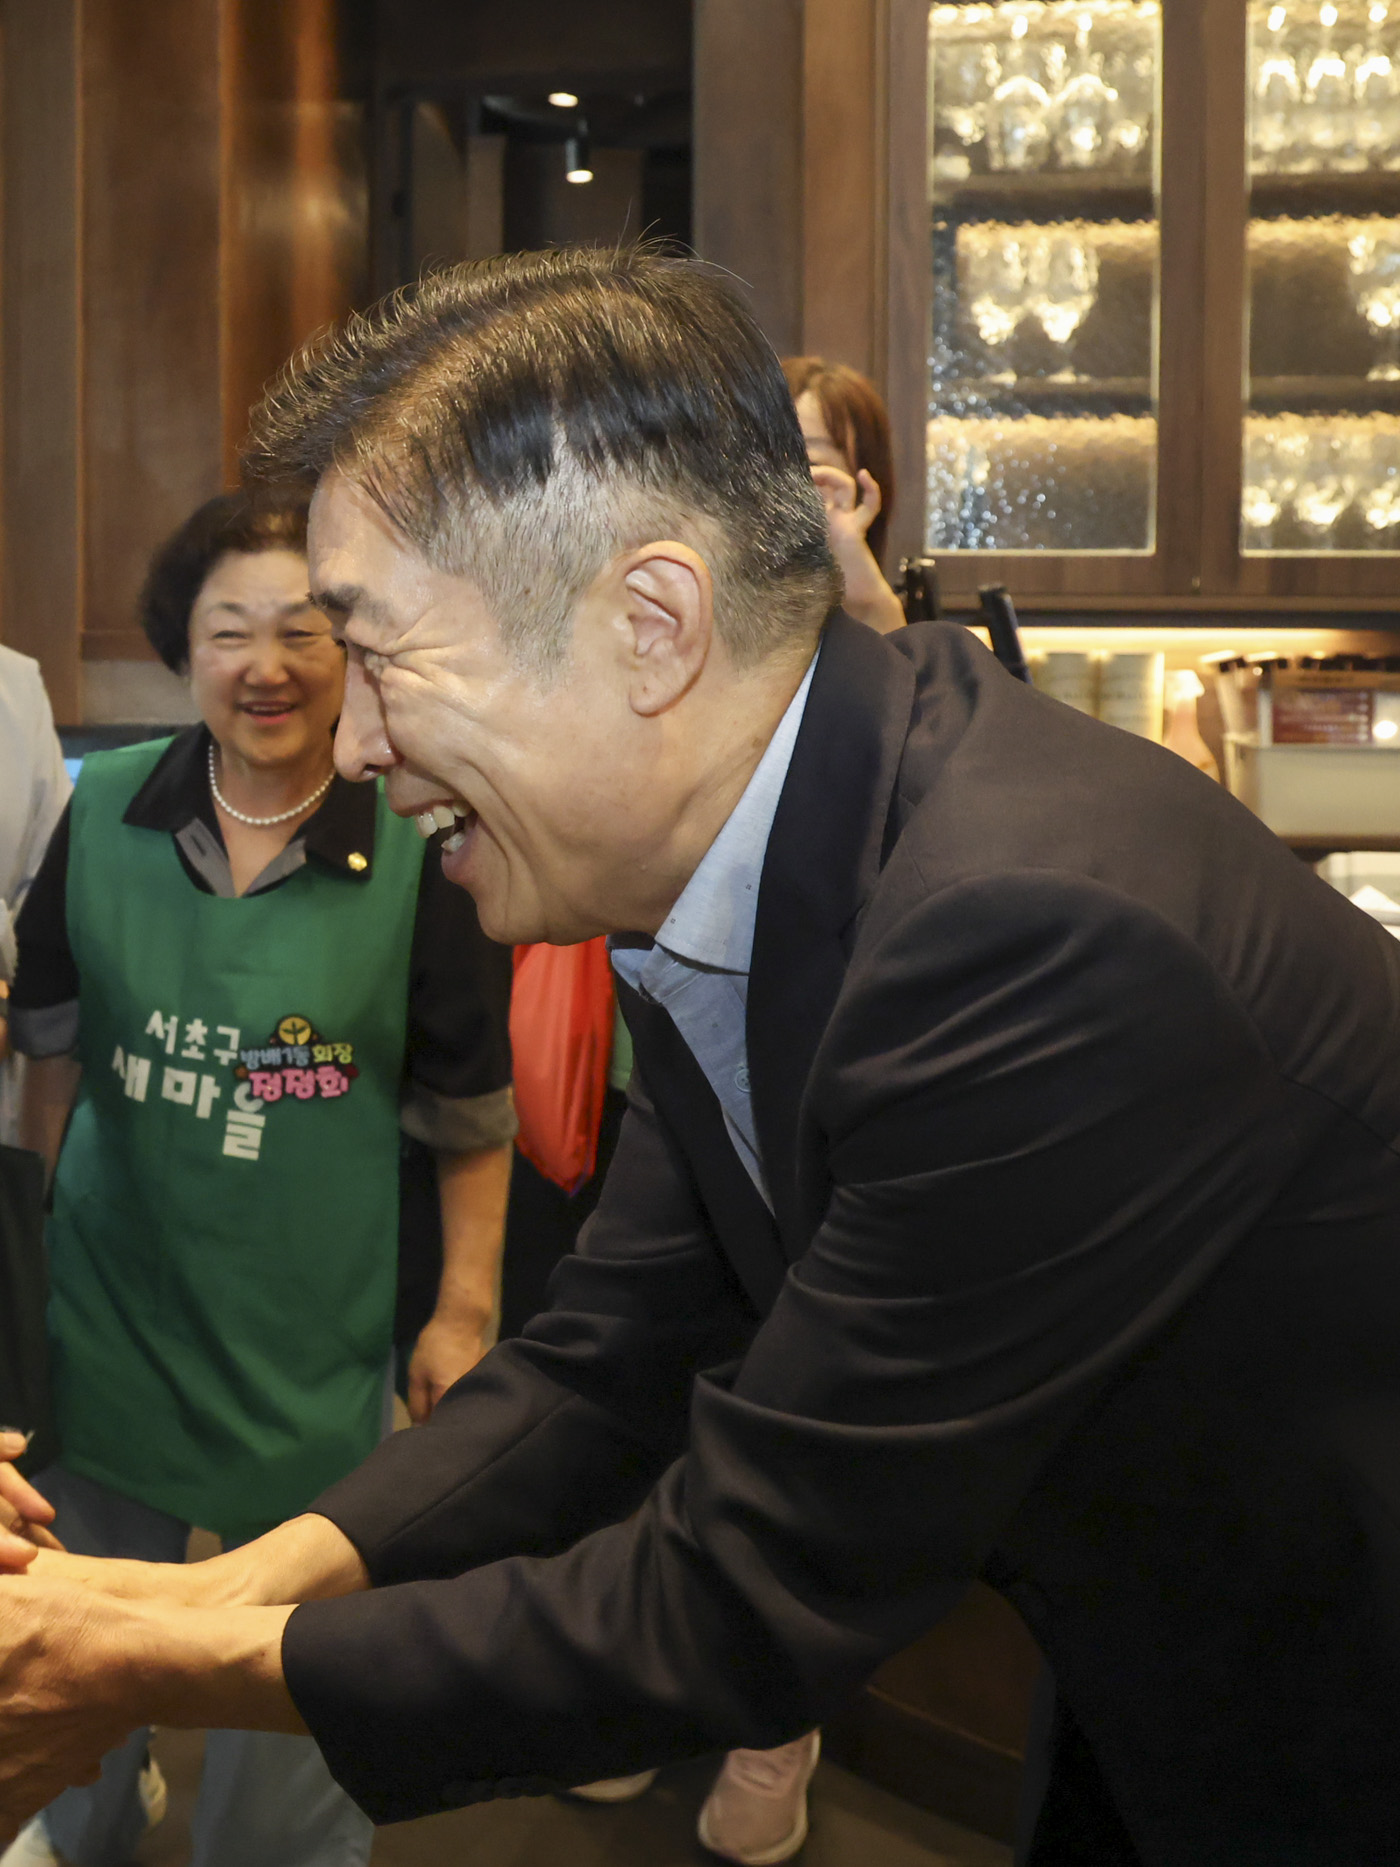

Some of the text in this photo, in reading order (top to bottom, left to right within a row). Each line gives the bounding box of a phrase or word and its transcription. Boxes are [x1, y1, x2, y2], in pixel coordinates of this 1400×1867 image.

[144, 1009, 241, 1067] 서초구
[311, 1042, 354, 1065] 회장
[111, 1044, 267, 1161] 새마을
